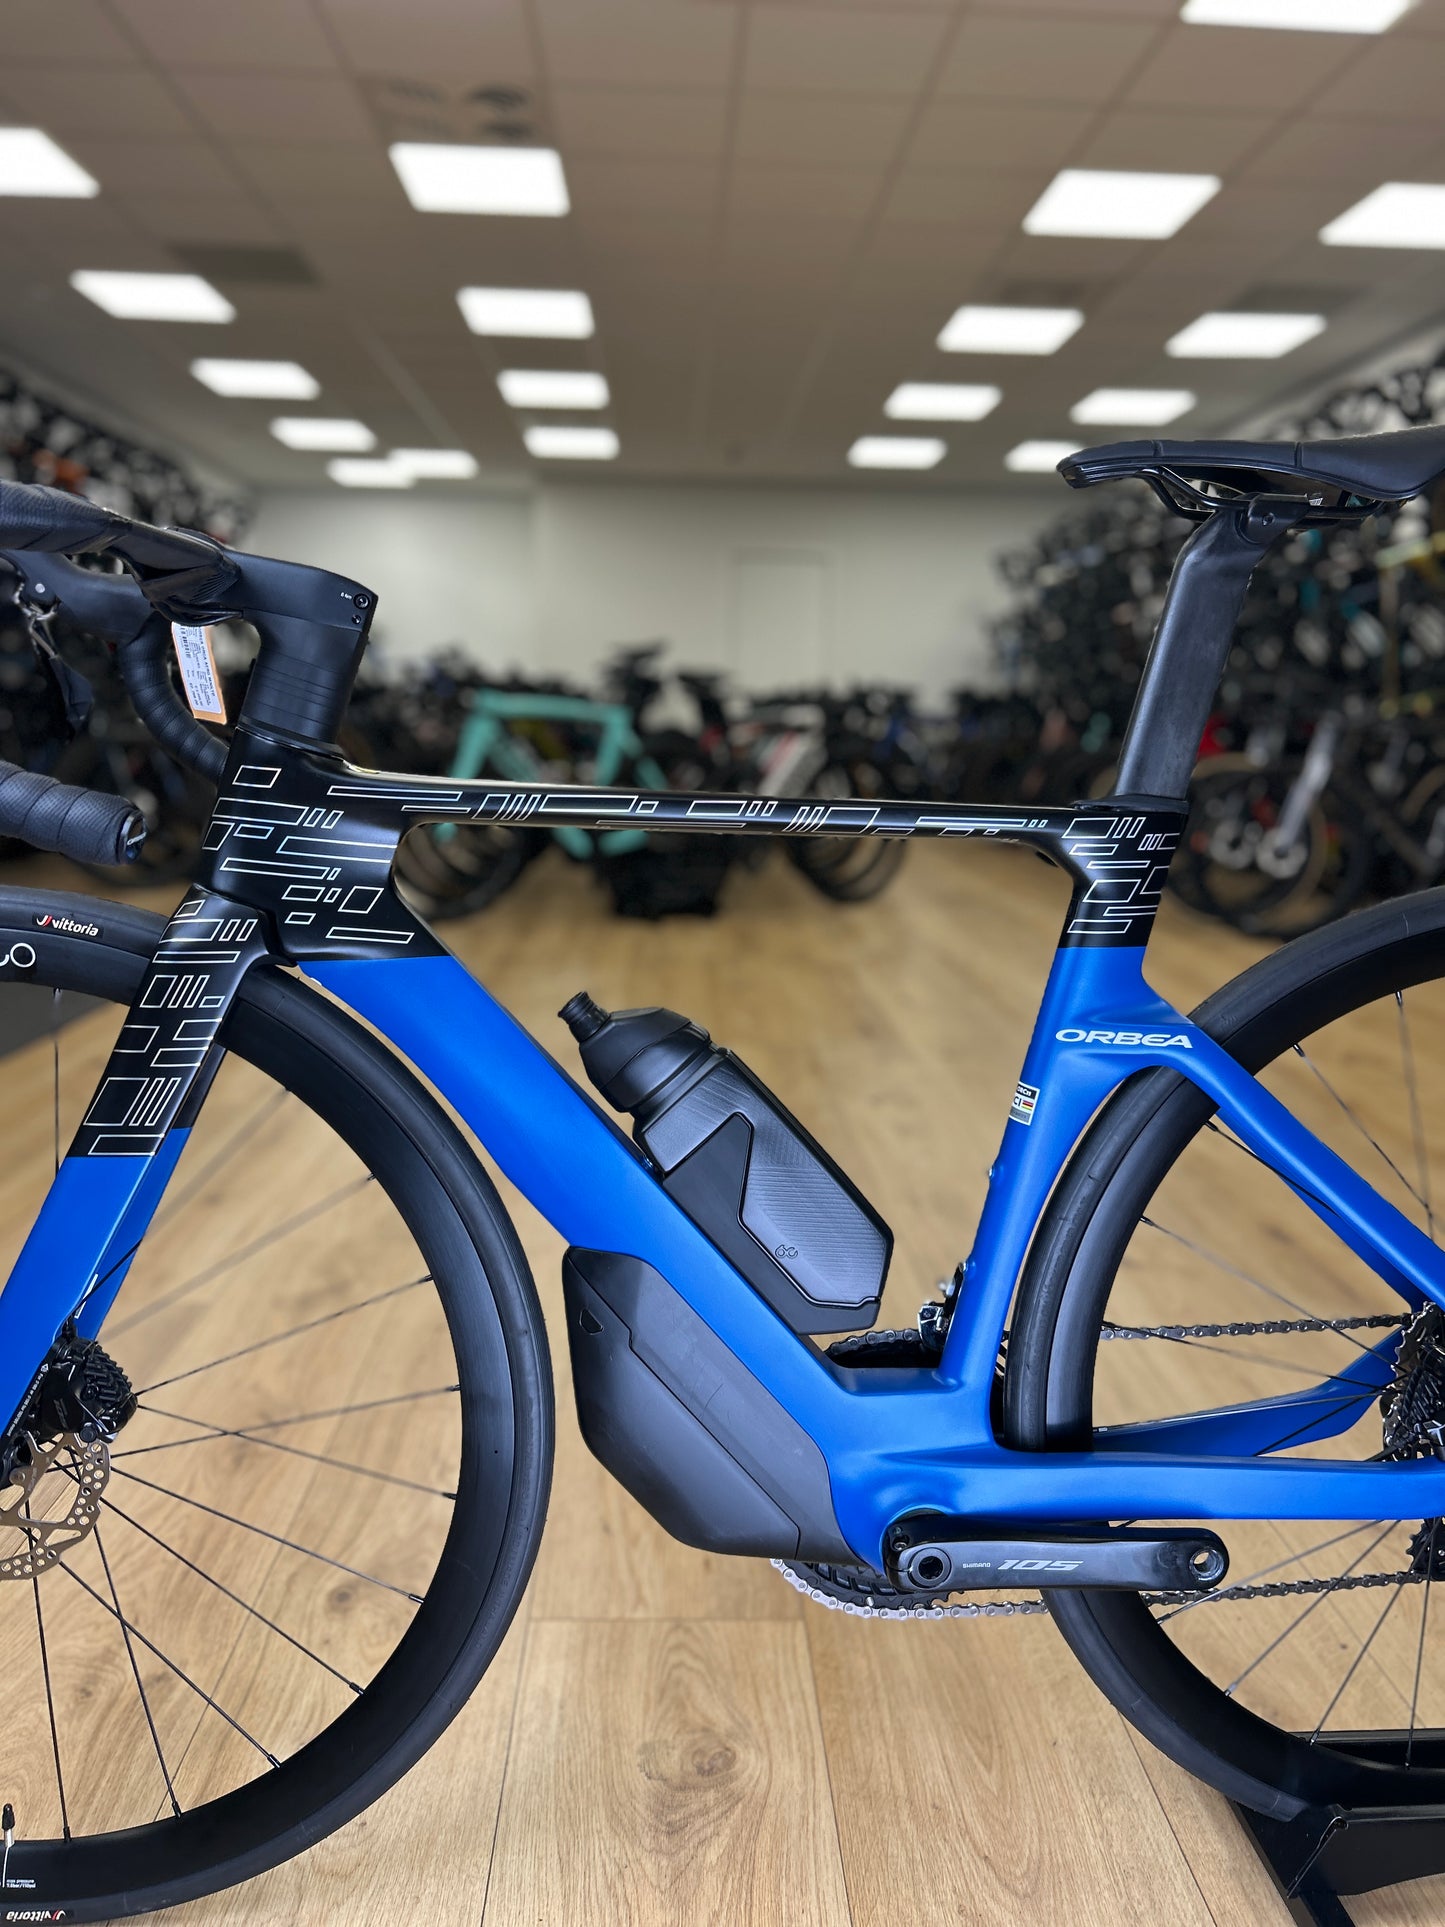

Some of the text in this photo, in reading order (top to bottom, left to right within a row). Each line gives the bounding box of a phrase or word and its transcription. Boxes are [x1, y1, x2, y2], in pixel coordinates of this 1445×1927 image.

[51, 917, 99, 936] vittoria
[1055, 1029, 1193, 1049] ORBEA
[997, 1559, 1084, 1571] 105
[6, 1910, 52, 1922] vittoria
